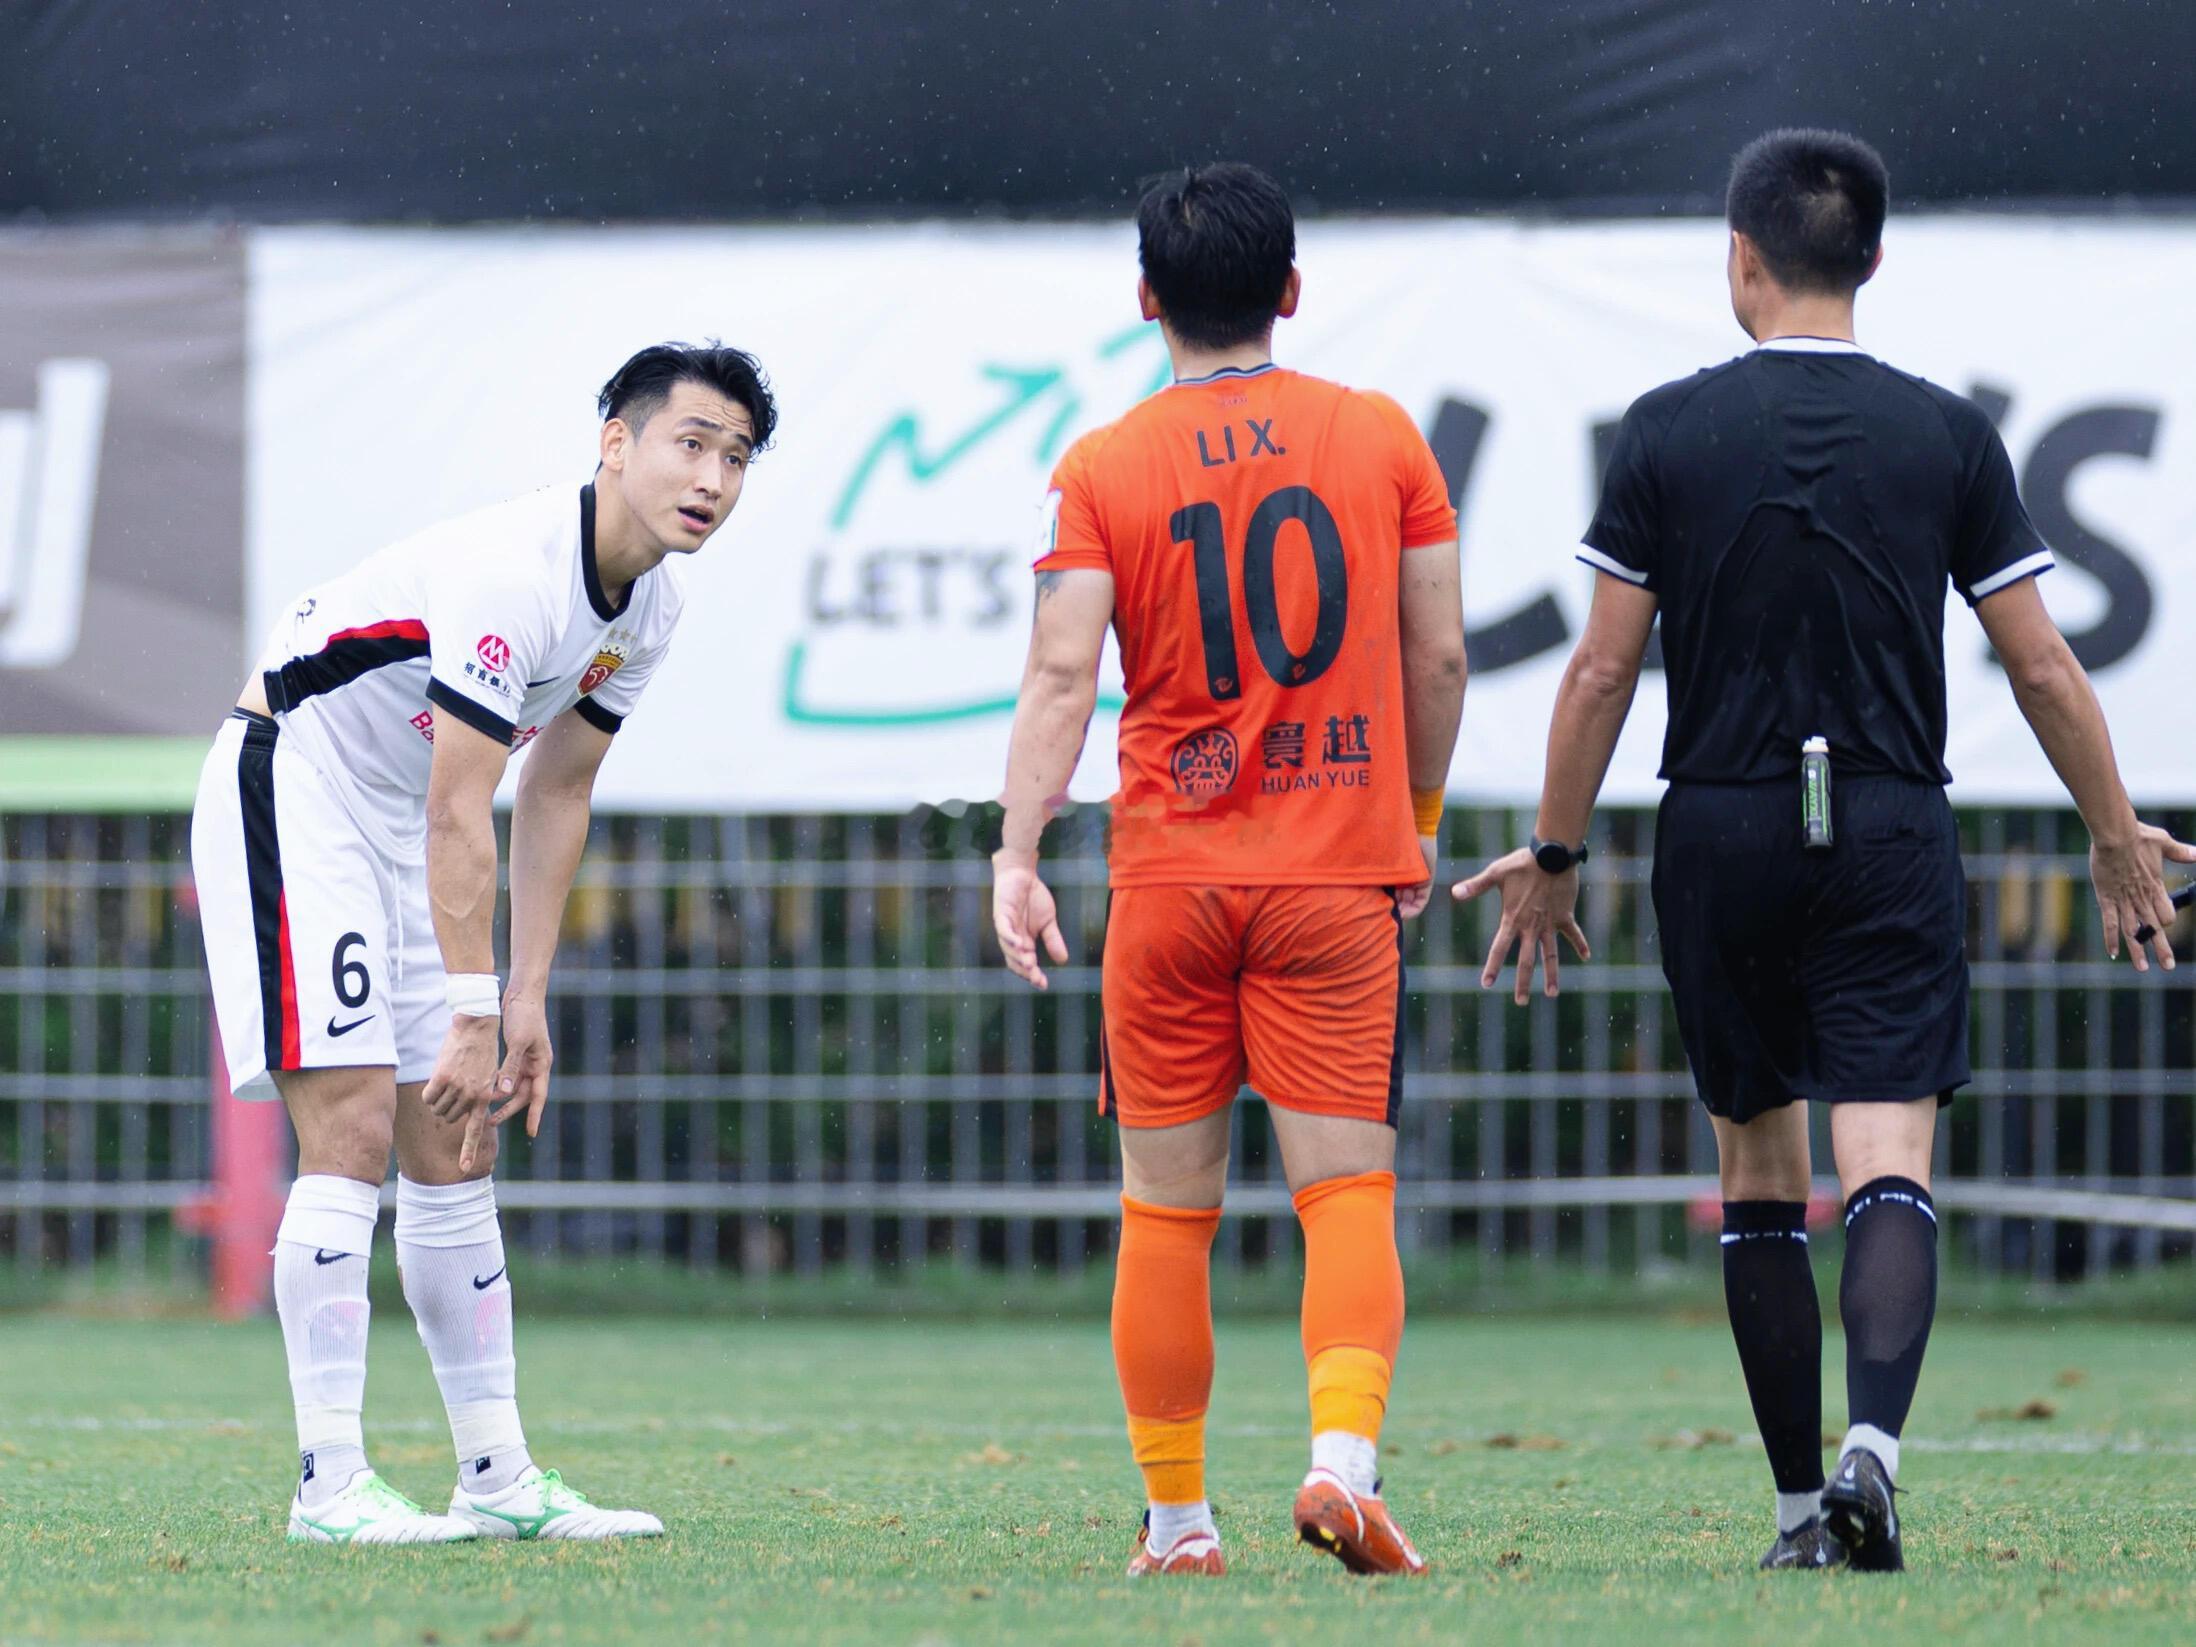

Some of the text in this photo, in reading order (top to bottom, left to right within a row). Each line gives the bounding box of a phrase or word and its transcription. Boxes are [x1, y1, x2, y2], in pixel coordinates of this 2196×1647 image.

[1196, 418, 1287, 467] LI X.
[806, 548, 1013, 626] LET'S
[1169, 485, 1348, 701] 10
[1261, 769, 1370, 794] HUAN YUE
[332, 931, 371, 1009] 6
